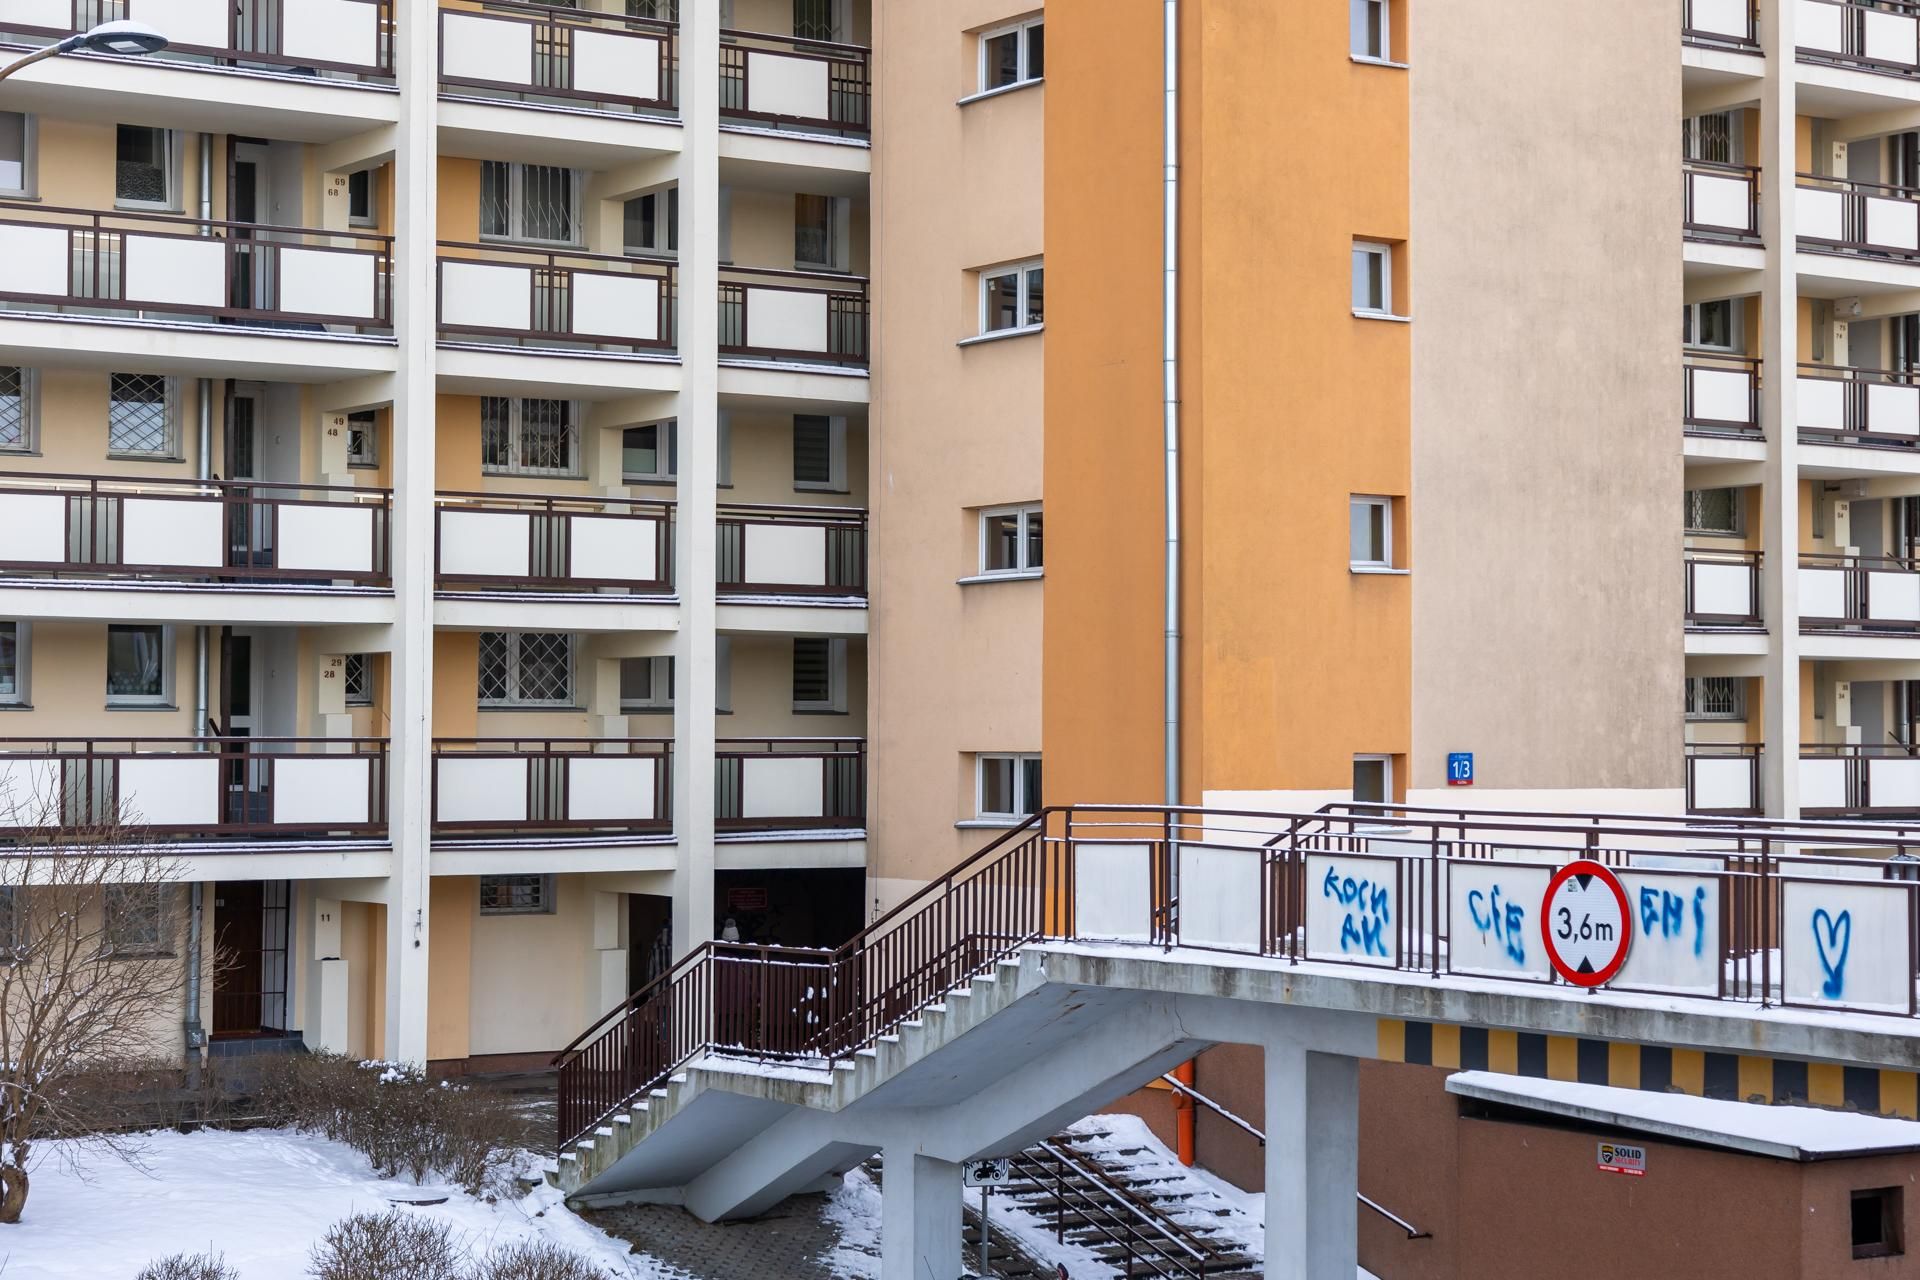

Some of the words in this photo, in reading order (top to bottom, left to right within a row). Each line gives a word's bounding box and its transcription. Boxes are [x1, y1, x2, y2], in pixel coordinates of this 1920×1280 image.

[335, 178, 345, 186] 69
[328, 188, 338, 196] 68
[333, 417, 344, 425] 49
[327, 428, 338, 436] 48
[331, 658, 342, 667] 29
[324, 670, 335, 678] 28
[1453, 760, 1470, 778] 1/3
[321, 914, 330, 922] 11
[1615, 1147, 1642, 1159] SOLID
